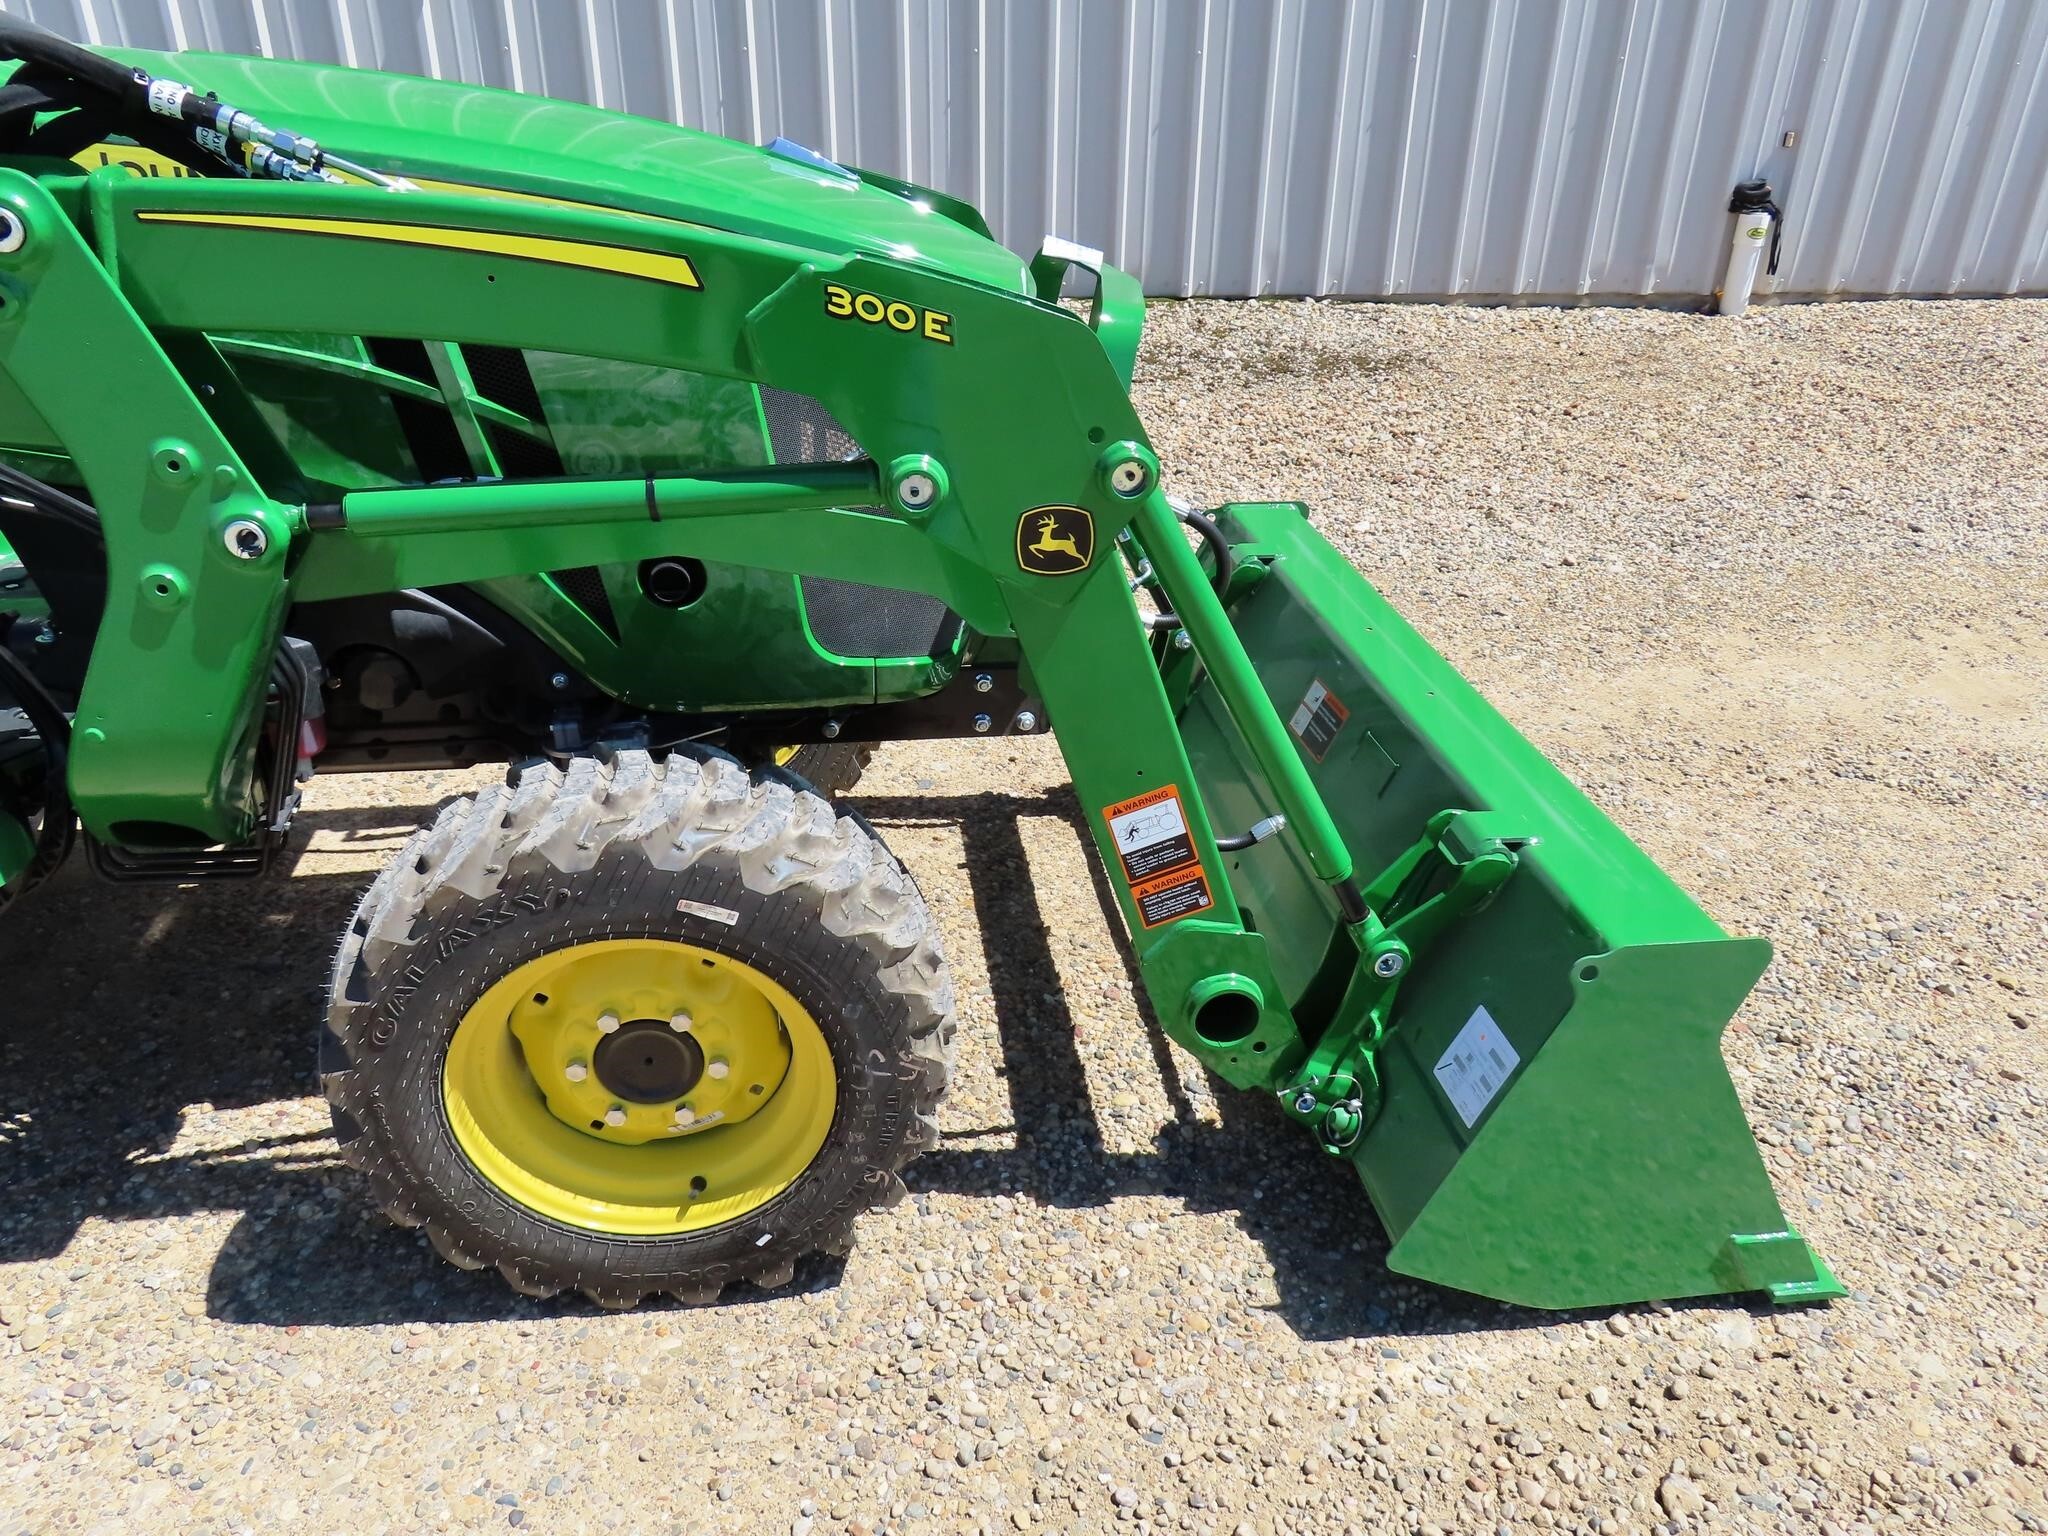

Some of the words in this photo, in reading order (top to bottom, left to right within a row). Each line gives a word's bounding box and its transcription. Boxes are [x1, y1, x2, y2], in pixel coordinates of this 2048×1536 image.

[826, 285, 917, 331] 300
[924, 310, 951, 342] E
[1123, 790, 1168, 811] WARNING
[1152, 870, 1196, 890] WARNING
